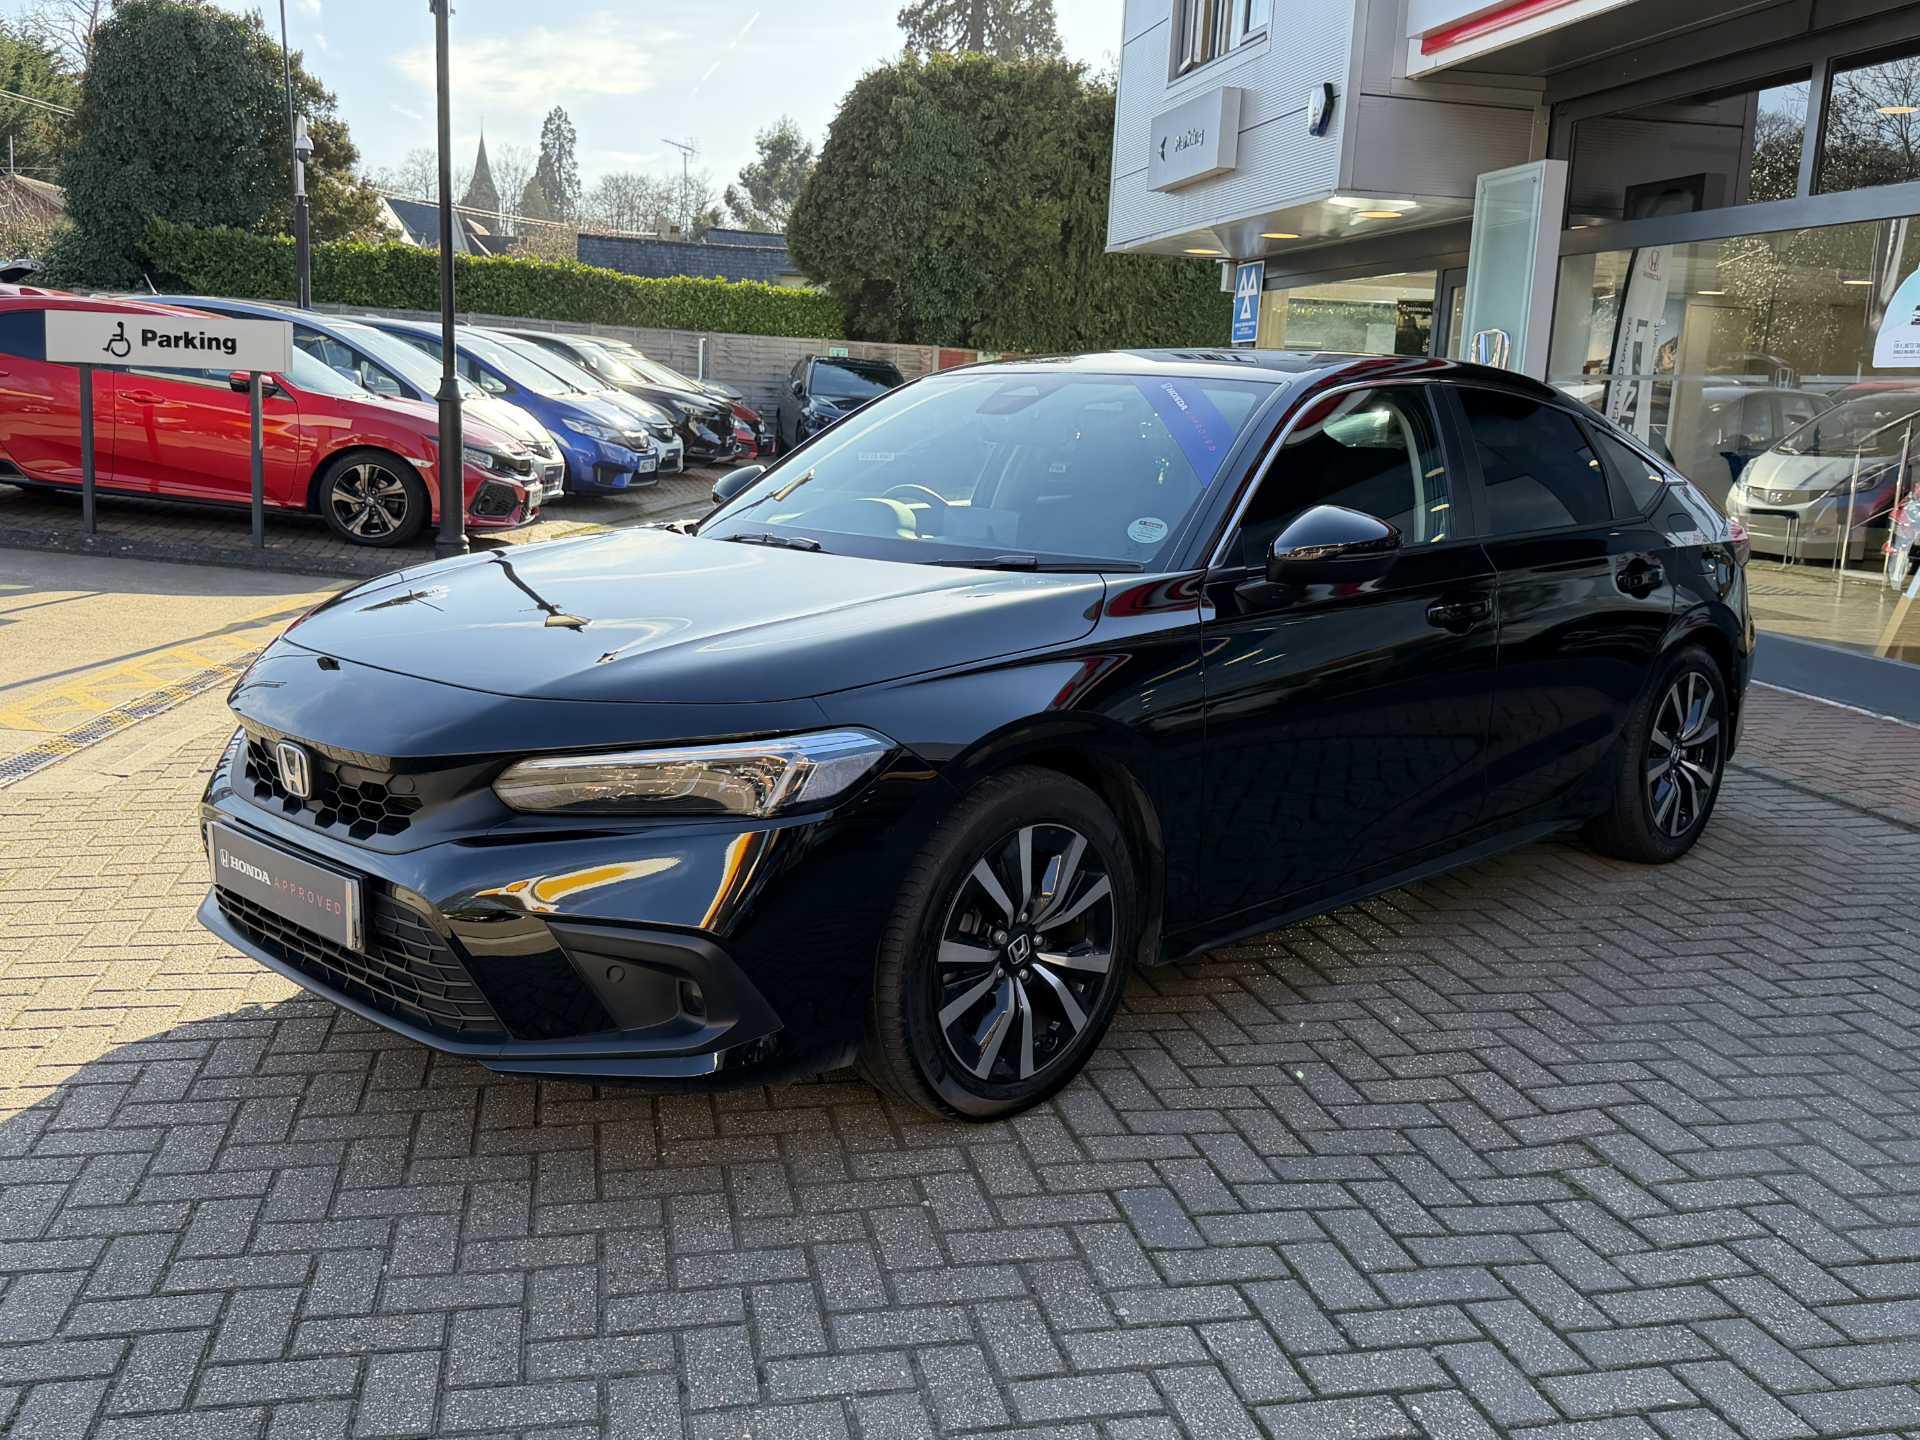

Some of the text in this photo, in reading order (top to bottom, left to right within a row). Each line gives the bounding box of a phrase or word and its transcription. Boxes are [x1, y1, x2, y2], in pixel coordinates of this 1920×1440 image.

[141, 328, 237, 355] Parking
[1166, 386, 1188, 411] HONDA
[230, 858, 342, 916] HONDA APPROVED
